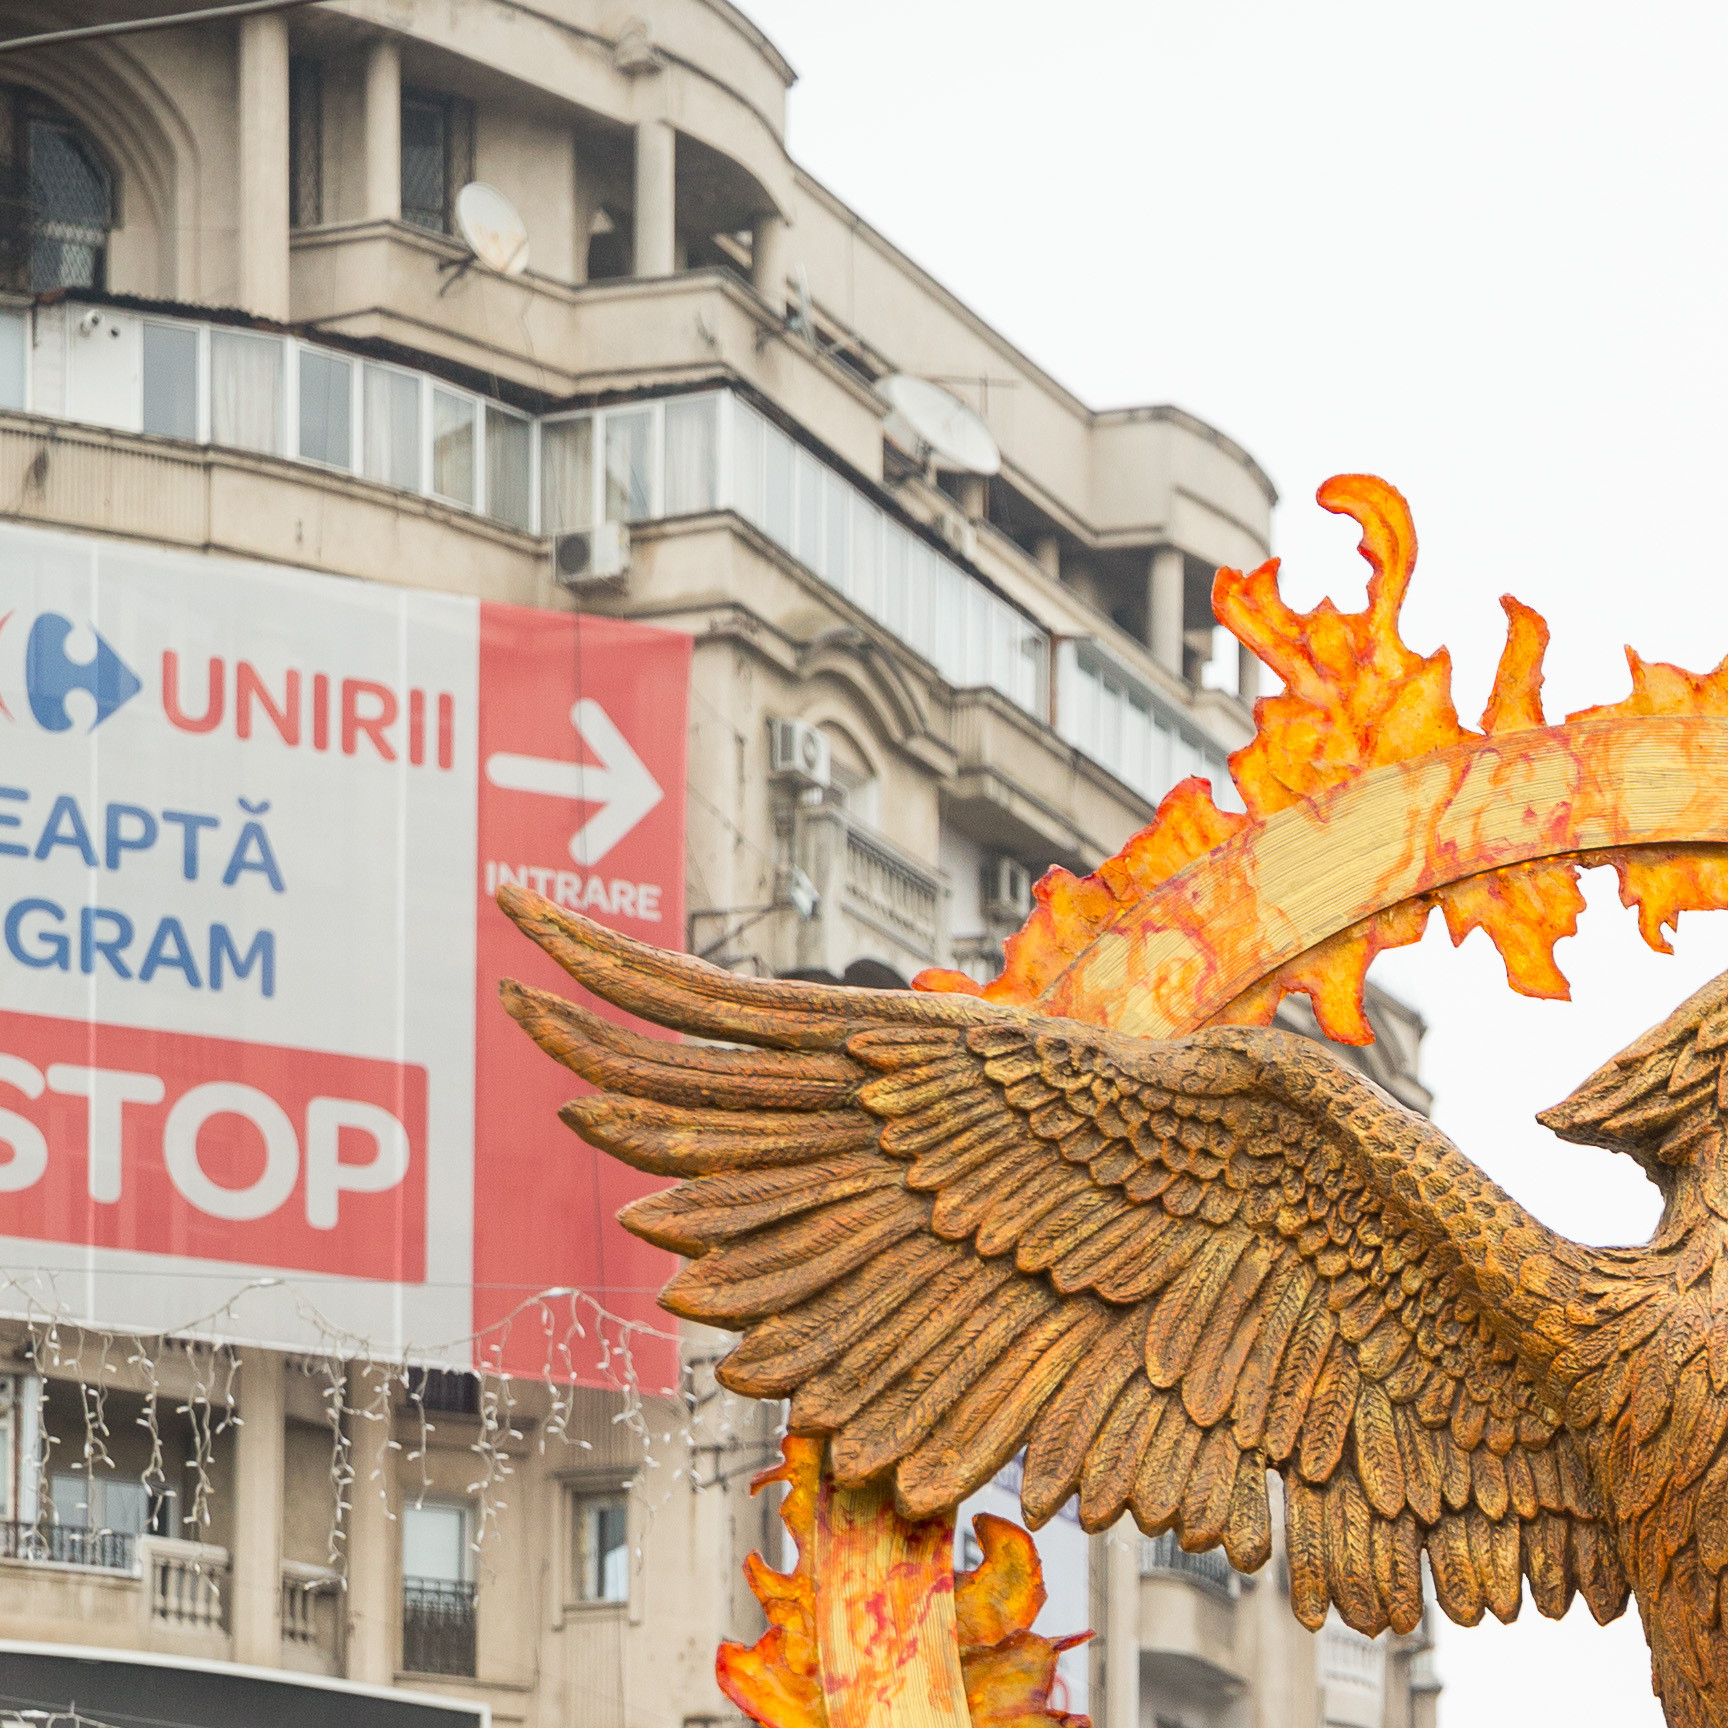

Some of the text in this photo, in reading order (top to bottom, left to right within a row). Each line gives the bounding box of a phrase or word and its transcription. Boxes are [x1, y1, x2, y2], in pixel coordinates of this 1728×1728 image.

[161, 650, 455, 771] UNIRII
[485, 860, 662, 922] INTRARE
[4, 897, 275, 998] GRAM
